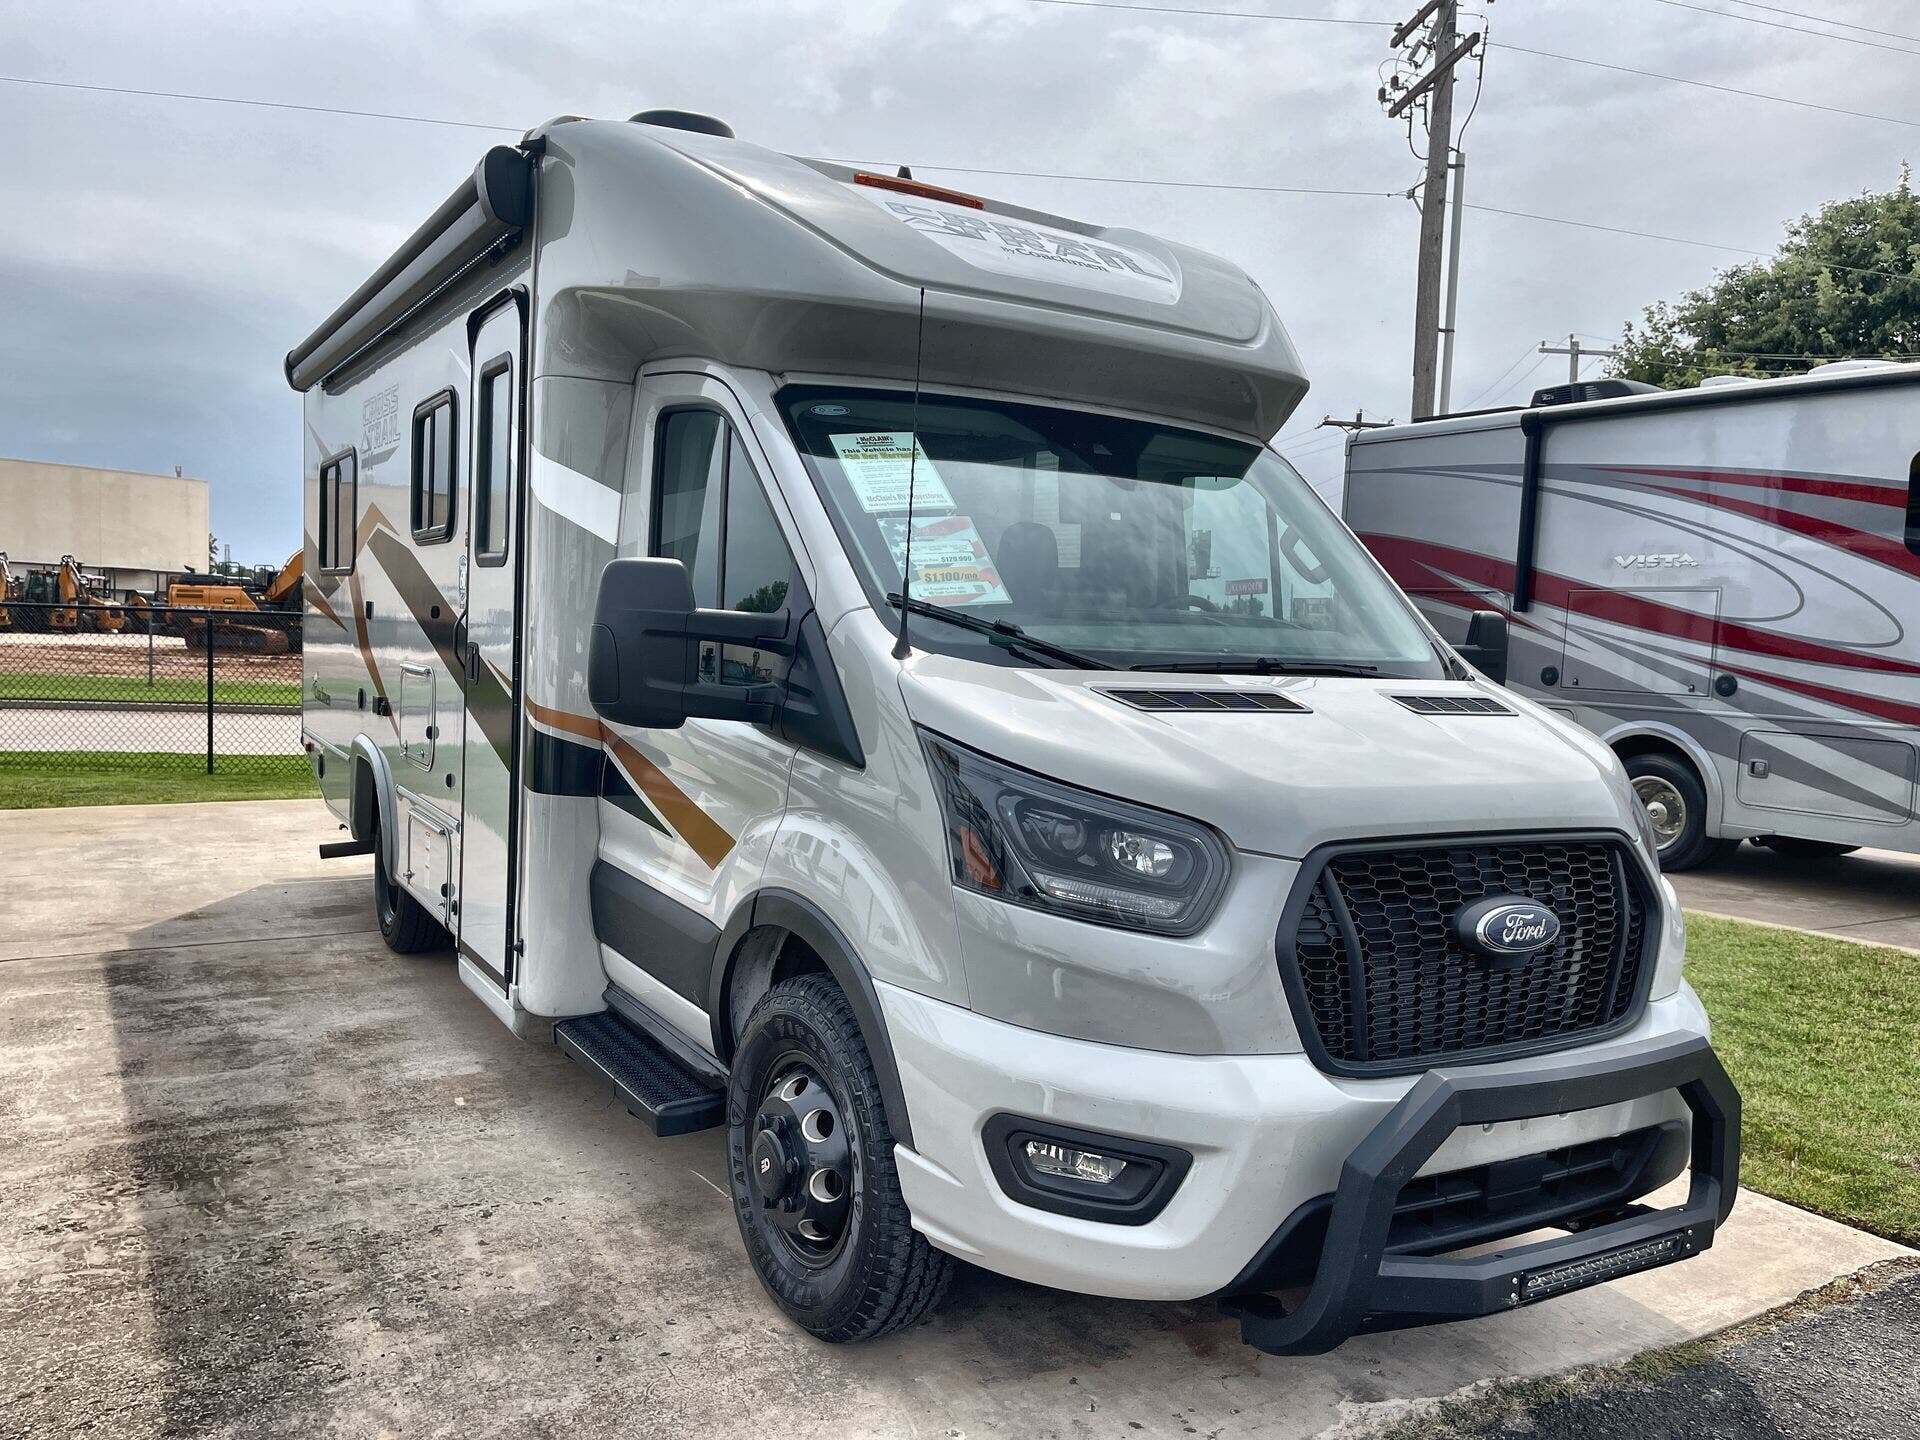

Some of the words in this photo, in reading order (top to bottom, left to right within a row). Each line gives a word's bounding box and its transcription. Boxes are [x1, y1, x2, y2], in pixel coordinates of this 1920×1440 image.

[1015, 247, 1111, 273] Coachmen
[362, 383, 400, 427] CROSS
[366, 413, 401, 450] TRAIL
[1613, 552, 1700, 569] VISTA
[1502, 913, 1547, 943] Ford
